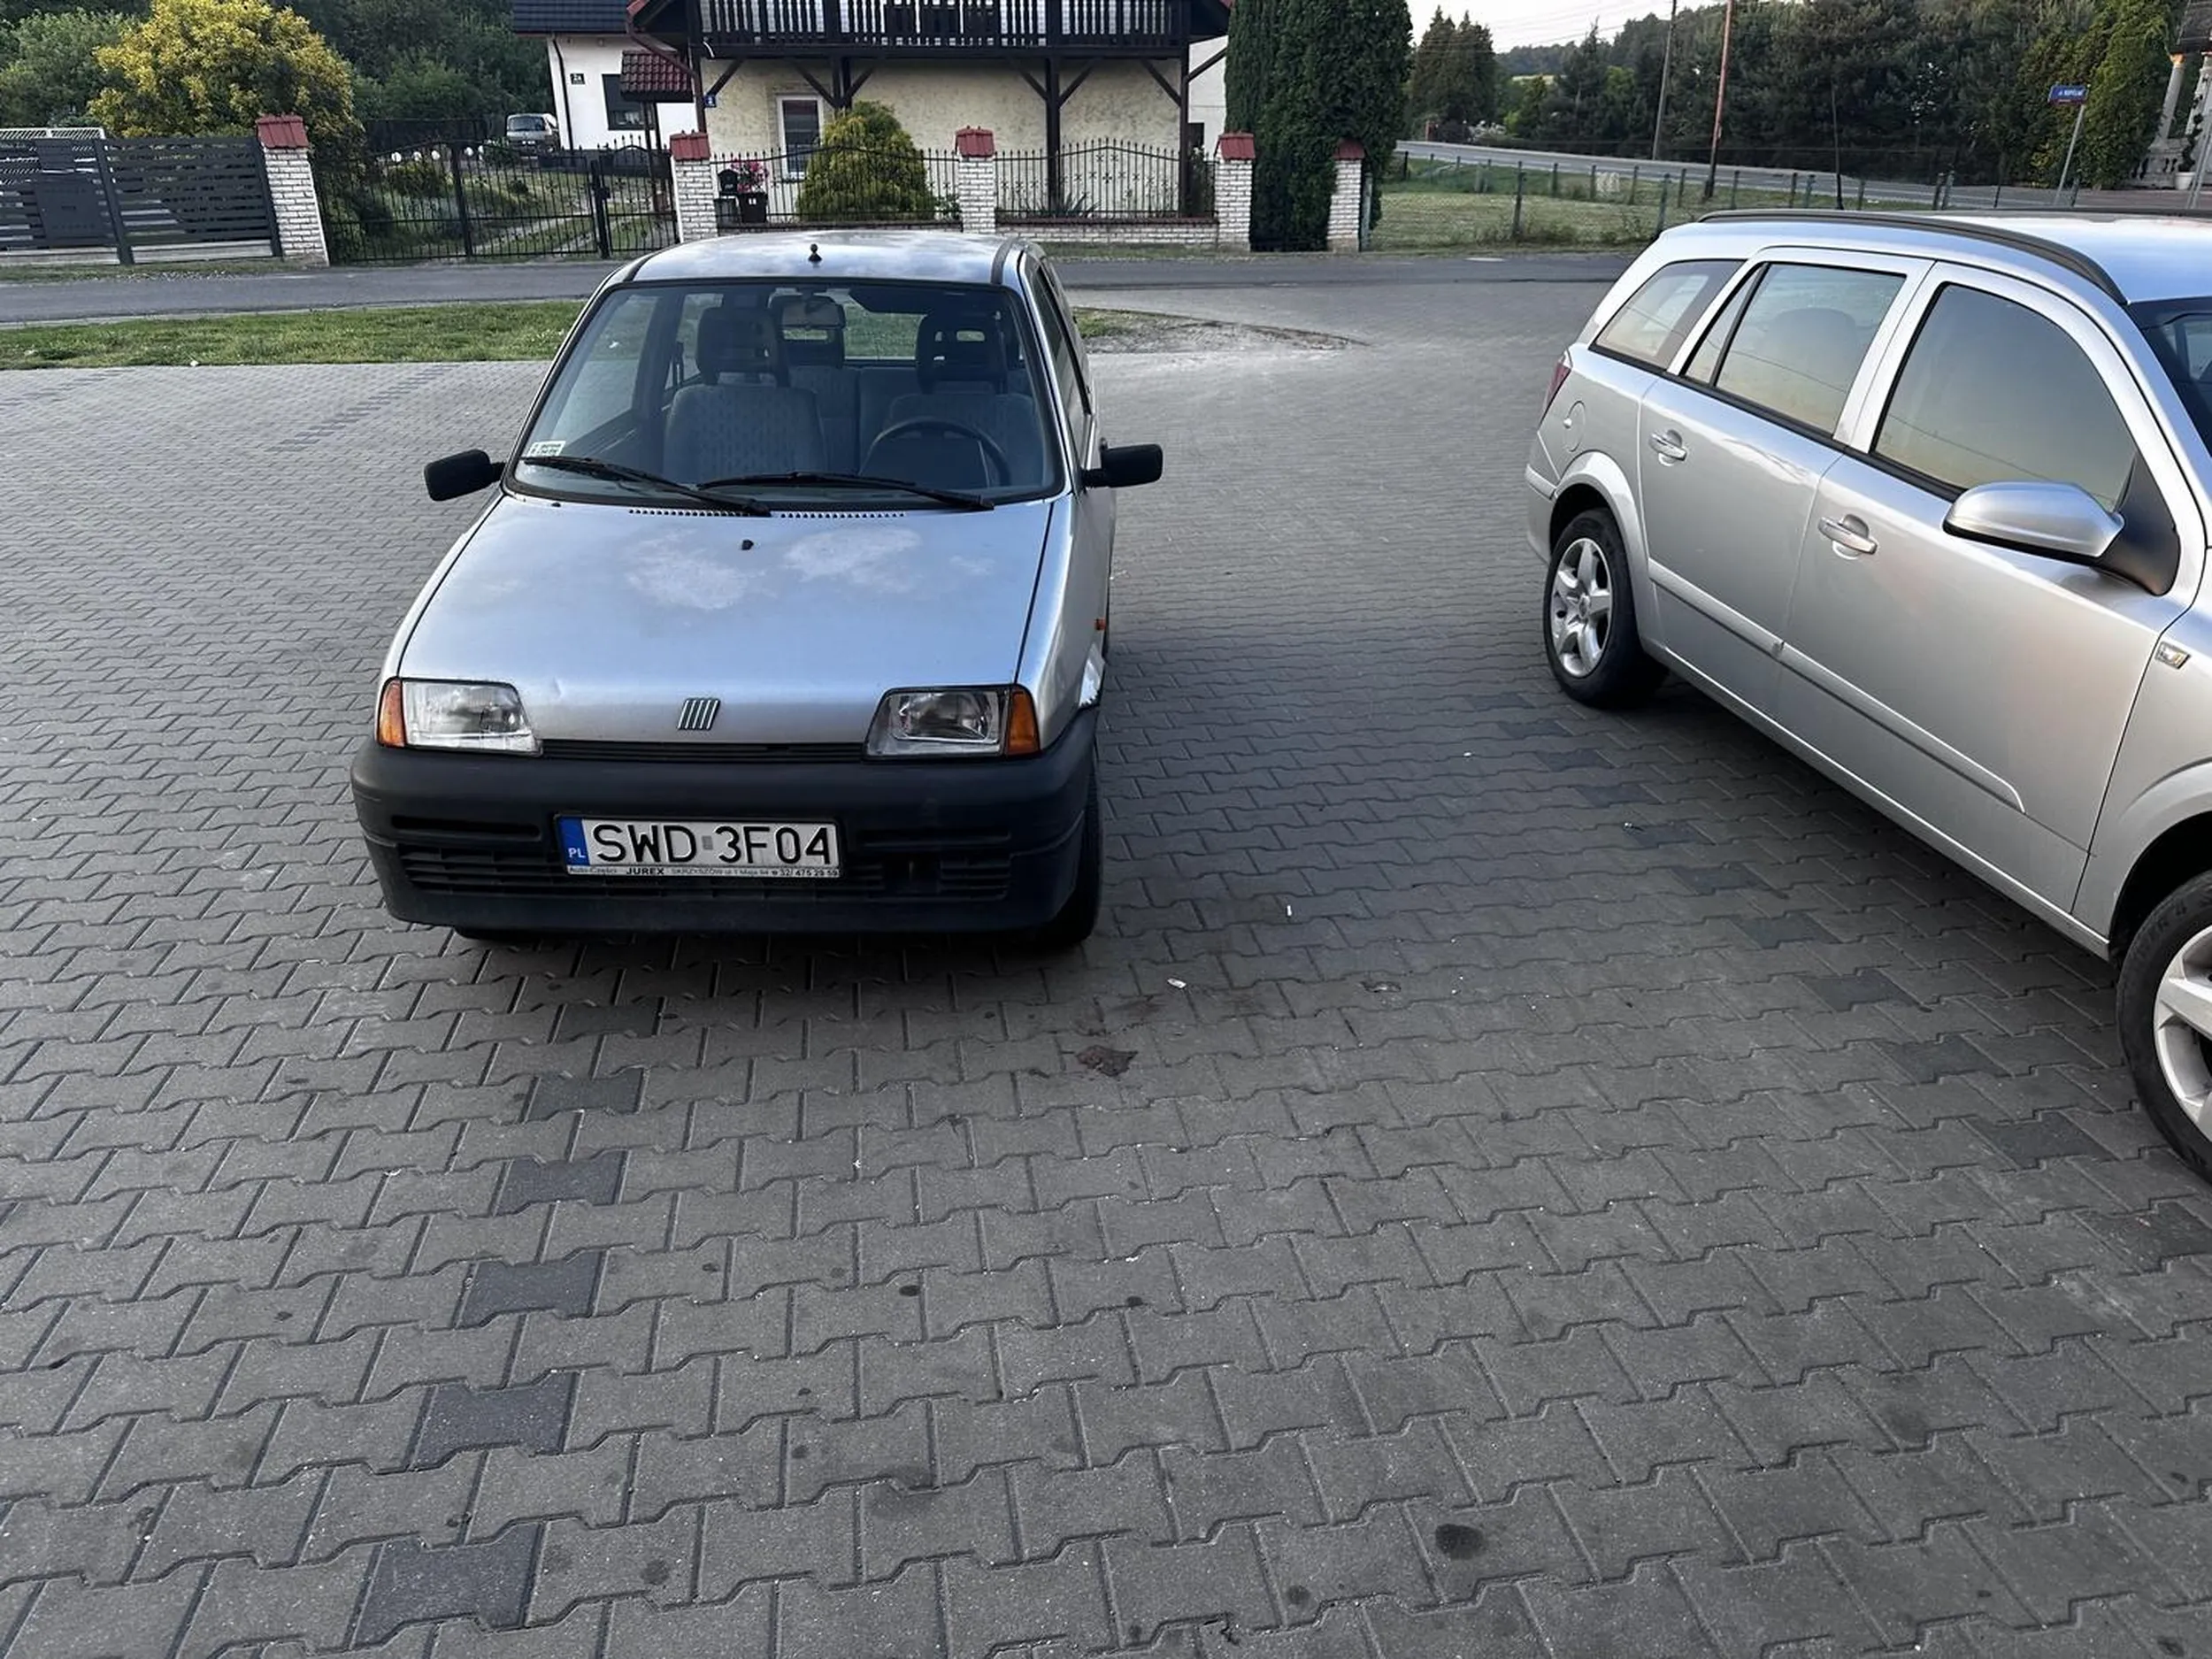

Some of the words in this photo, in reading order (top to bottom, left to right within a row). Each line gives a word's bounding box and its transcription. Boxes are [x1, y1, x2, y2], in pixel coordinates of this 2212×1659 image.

[568, 847, 586, 858] PL
[593, 824, 697, 863] SWD
[715, 826, 831, 864] 3F04
